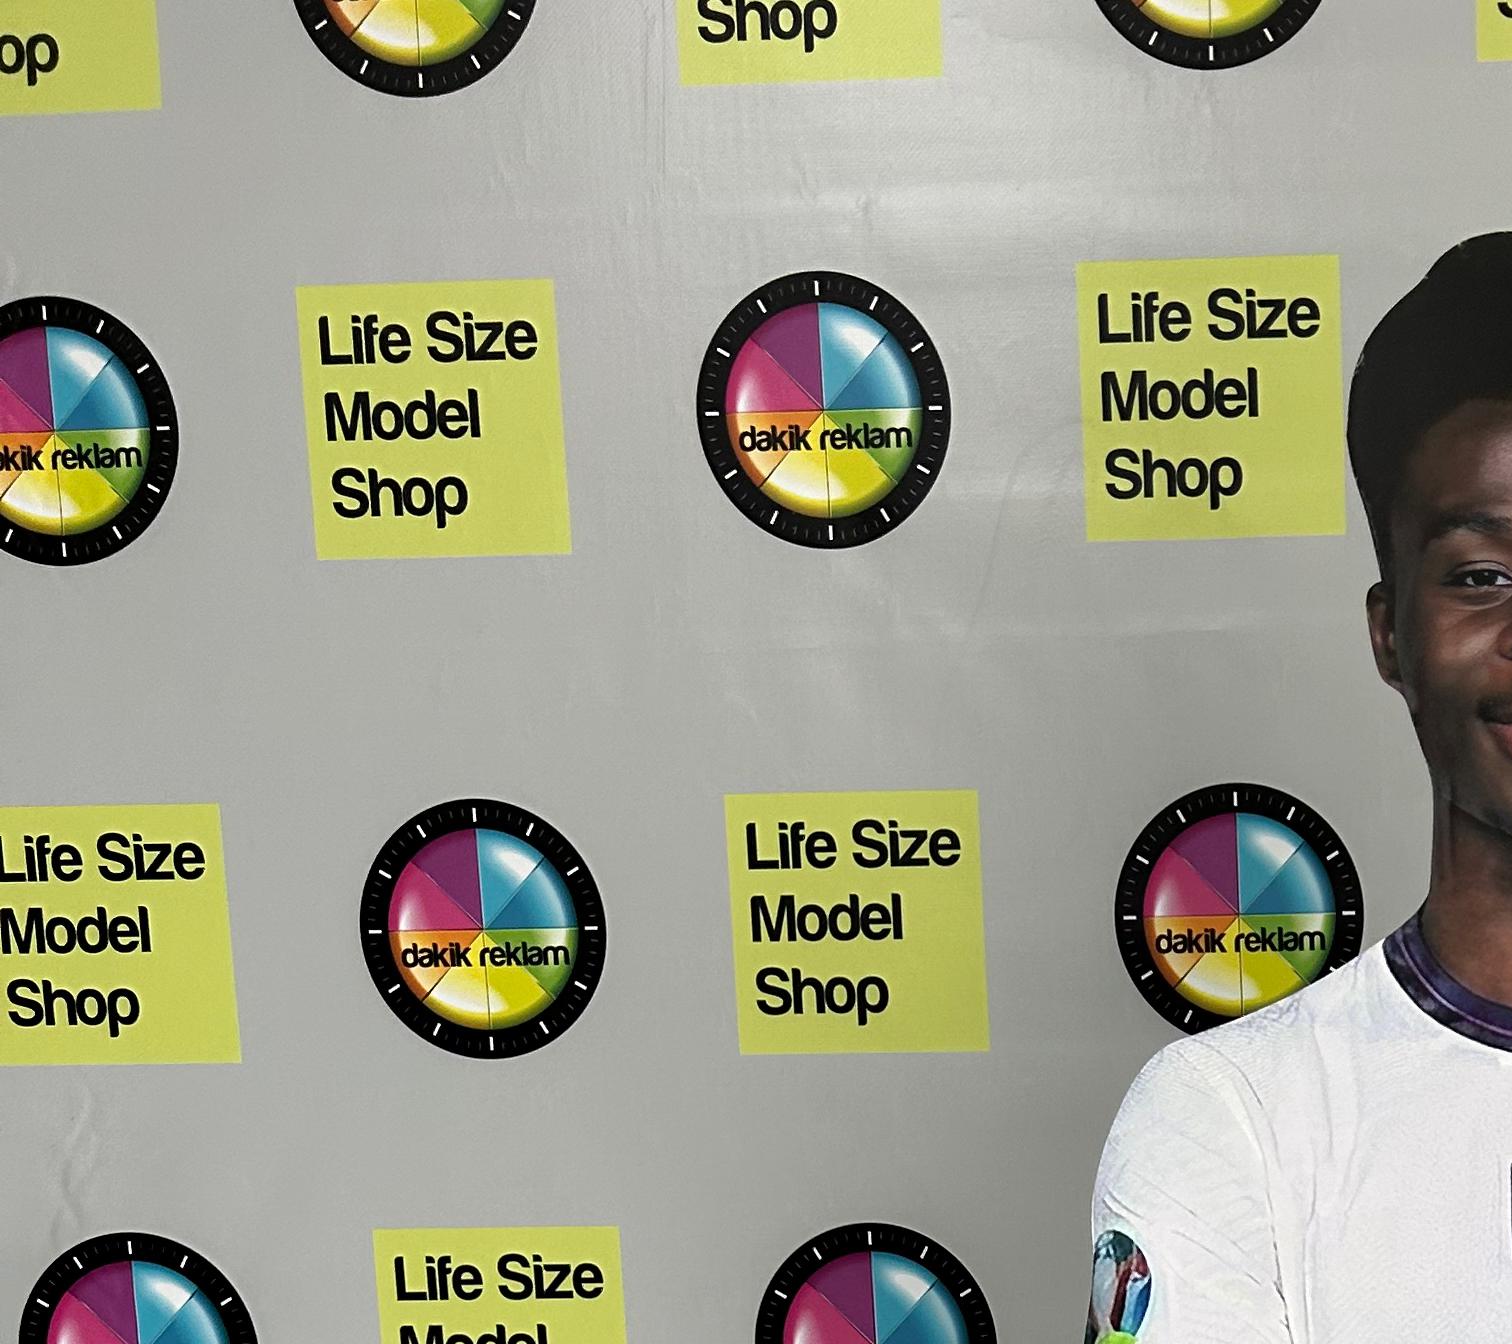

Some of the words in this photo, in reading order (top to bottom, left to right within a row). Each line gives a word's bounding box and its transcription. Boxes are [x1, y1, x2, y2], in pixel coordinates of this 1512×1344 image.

[697, 0, 838, 53] Shop
[0, 33, 60, 86] op
[318, 314, 412, 366] Life
[425, 310, 538, 363] Size
[1097, 291, 1192, 344] Life
[1207, 287, 1321, 341] Size
[324, 388, 481, 442] Model
[1100, 366, 1259, 422] Model
[0, 445, 45, 471] kik
[51, 443, 142, 470] reklam
[738, 424, 812, 452] dakik
[819, 422, 914, 451] reklam
[331, 467, 469, 529] Shop
[1105, 448, 1243, 511] Shop
[96, 832, 206, 882] Size
[745, 821, 838, 870] Life
[851, 819, 961, 869] Size
[0, 905, 152, 955] Model
[750, 892, 904, 943] Model
[1155, 928, 1227, 955] dakik
[1234, 928, 1327, 955] reklam
[401, 942, 473, 968] dakik
[479, 941, 571, 967] reklam
[6, 978, 140, 1038] Shop
[755, 966, 890, 1027] Shop
[394, 1255, 484, 1302] Life
[497, 1253, 604, 1301] Size
